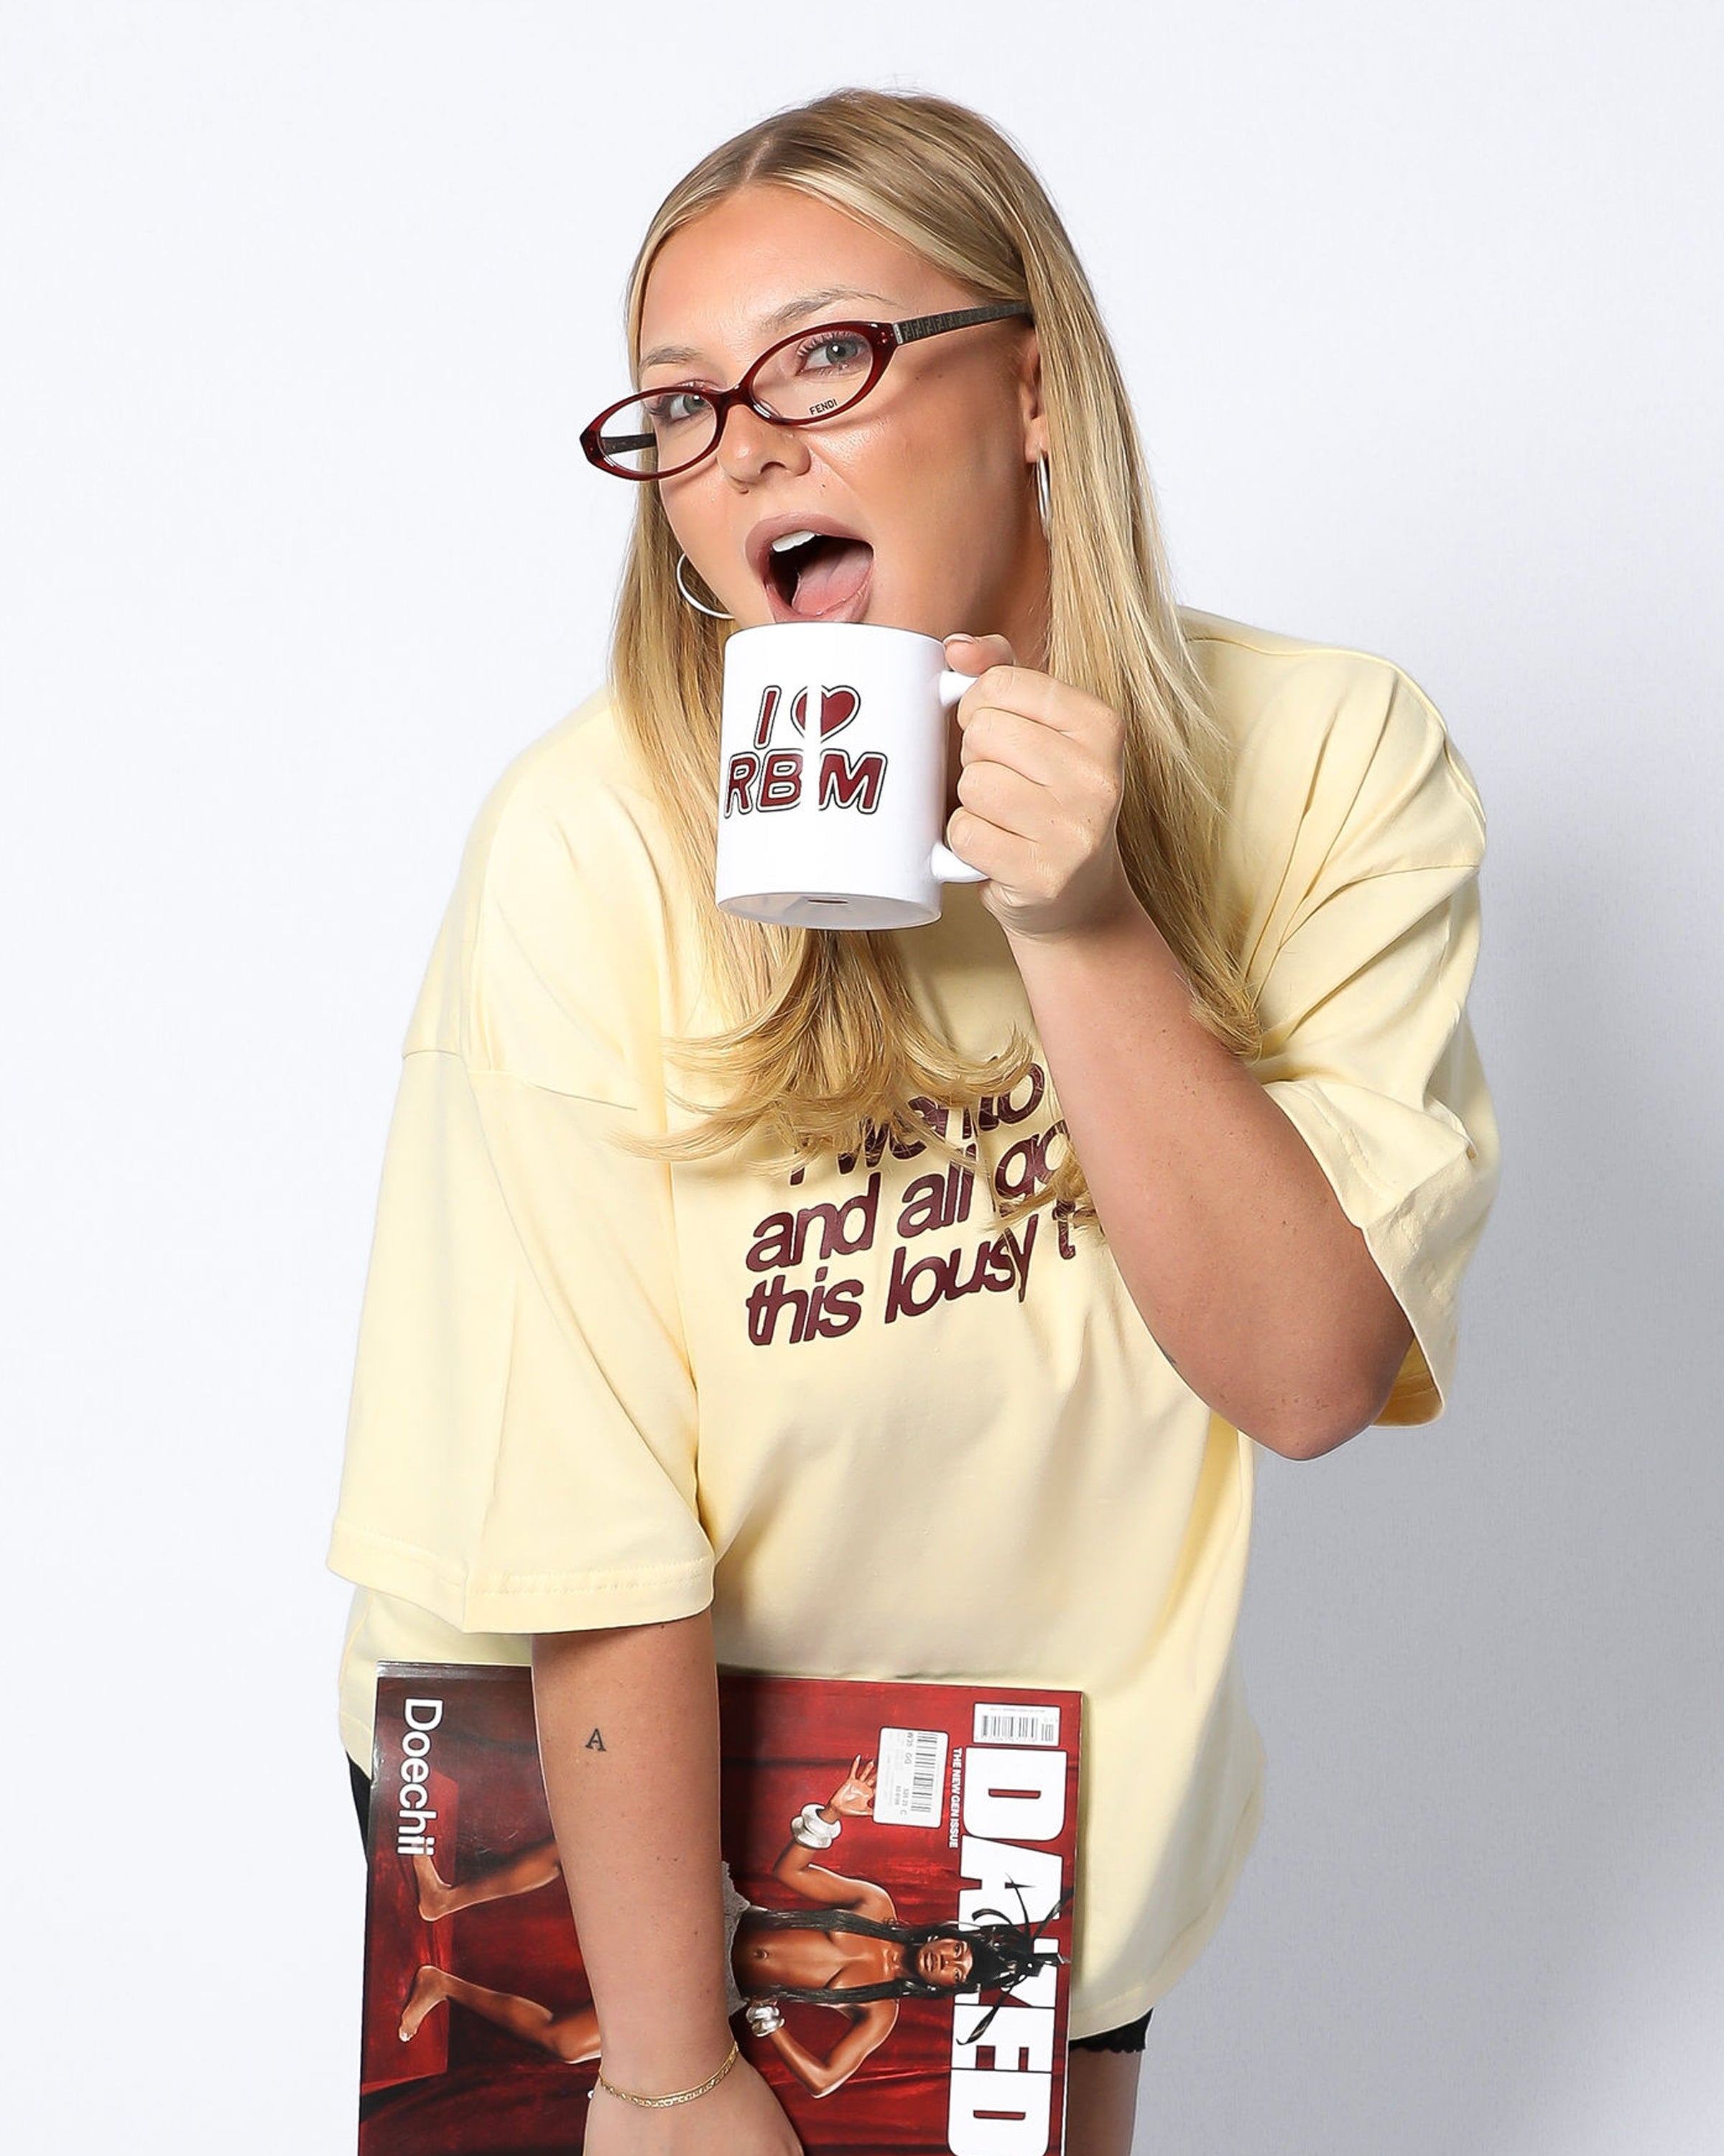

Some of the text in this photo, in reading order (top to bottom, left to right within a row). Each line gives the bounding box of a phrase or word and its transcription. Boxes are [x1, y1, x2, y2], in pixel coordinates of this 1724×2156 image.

[809, 398, 838, 415] FENDI
[754, 685, 782, 750] I
[724, 747, 888, 819] RBM
[746, 1171, 881, 1272] and
[897, 1143, 976, 1239] all
[746, 1266, 864, 1346] this
[884, 1213, 1039, 1324] lousy
[397, 1698, 444, 1856] Doechii
[585, 1727, 607, 1752] A
[948, 1747, 963, 1849] THE NEW GEN ISSUE
